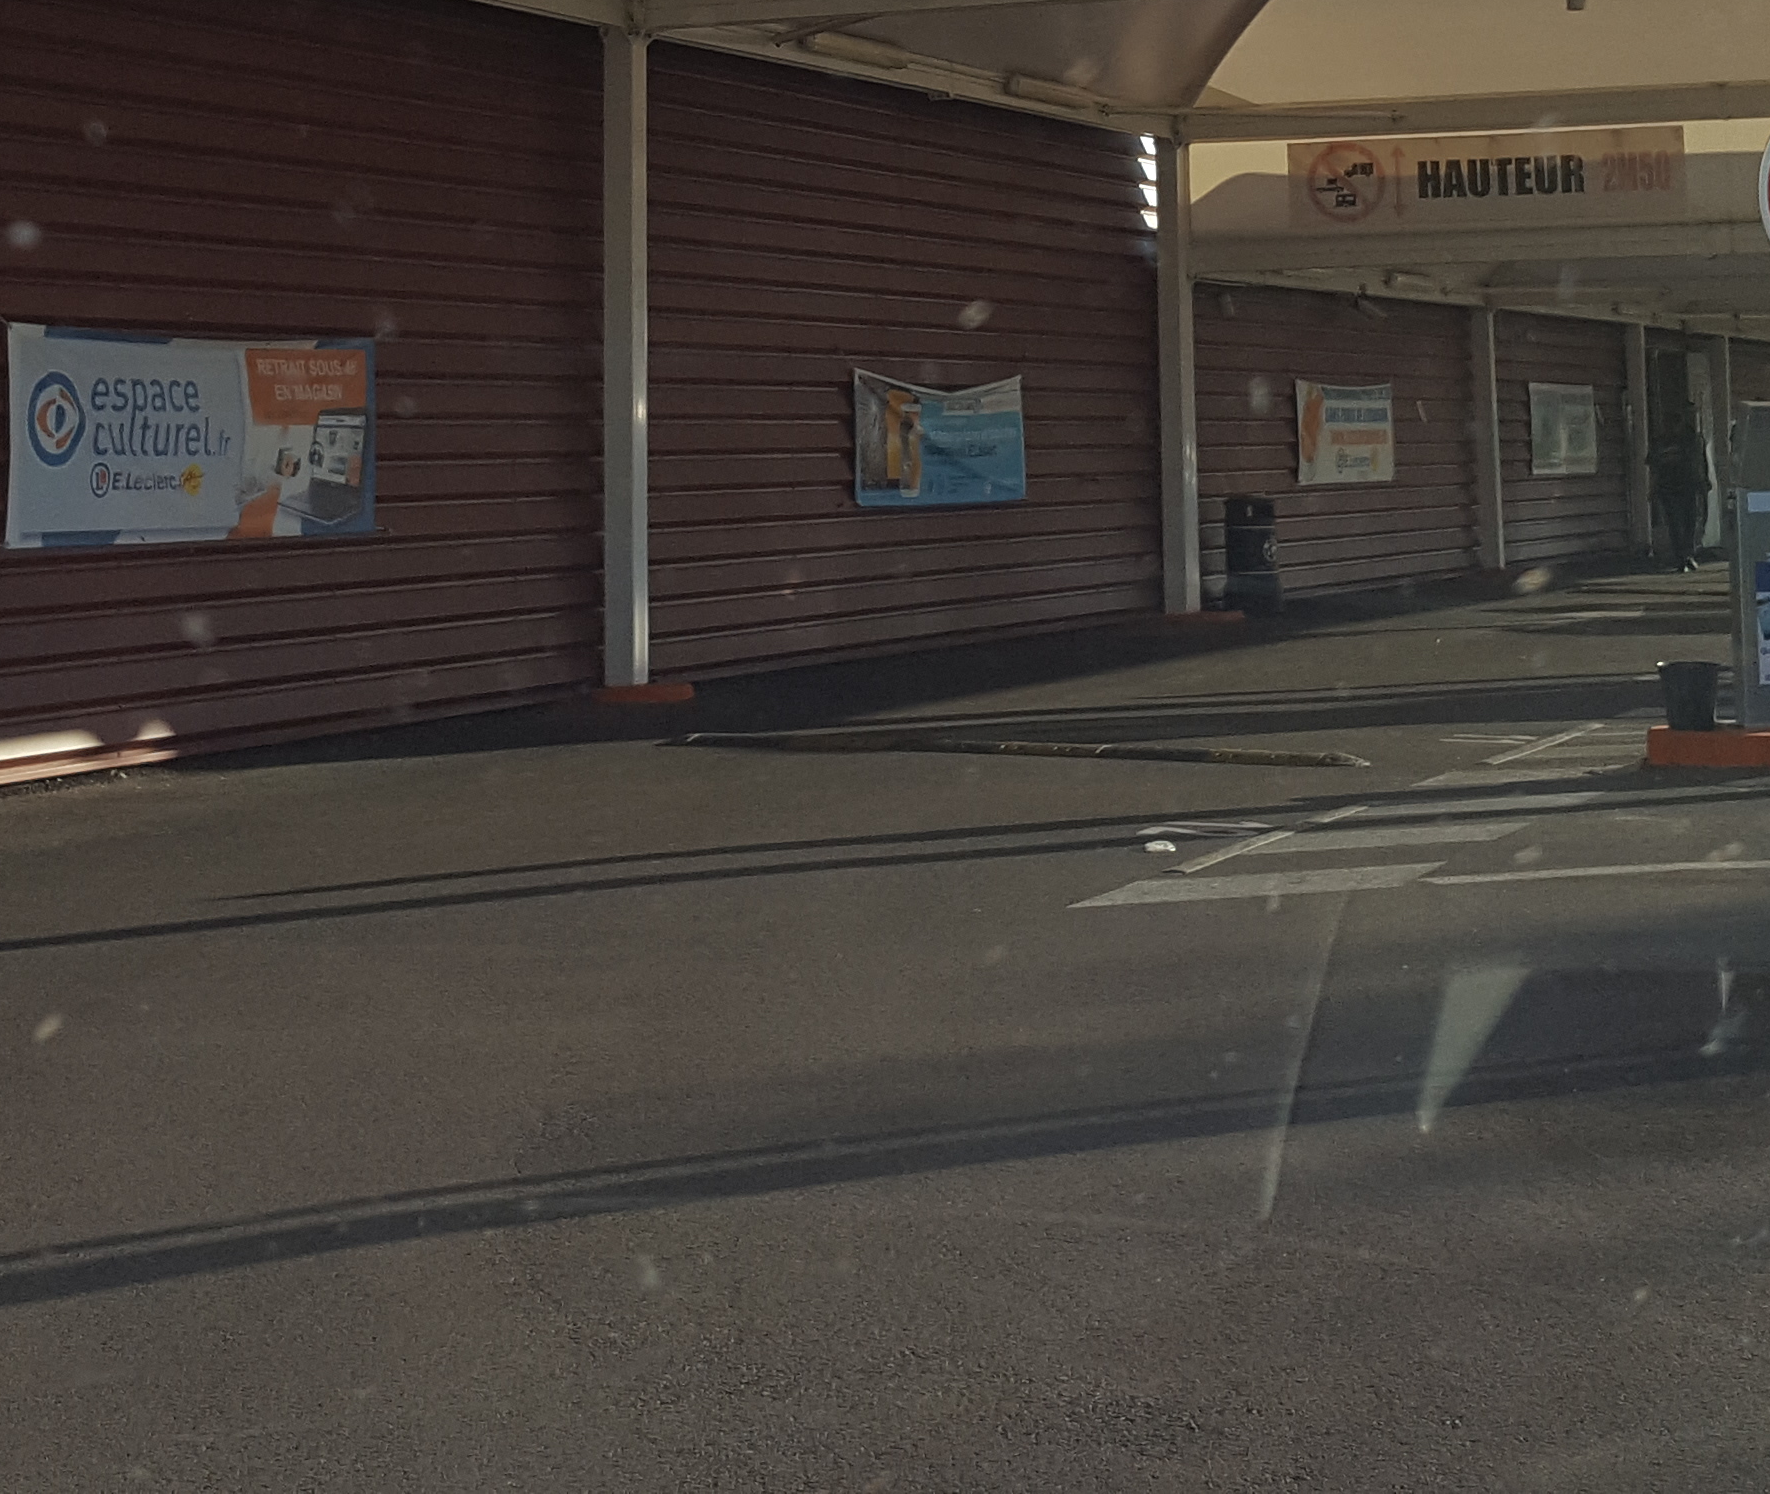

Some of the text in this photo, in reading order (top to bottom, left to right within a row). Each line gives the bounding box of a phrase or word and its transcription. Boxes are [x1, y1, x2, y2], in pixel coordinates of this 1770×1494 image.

[1417, 155, 1585, 198] HAUTEUR
[256, 358, 306, 375] RETRAIT
[309, 359, 342, 375] SOUS
[91, 377, 201, 416] espace
[93, 415, 230, 457] culturel.fr
[112, 472, 177, 491] E.Leclerc
